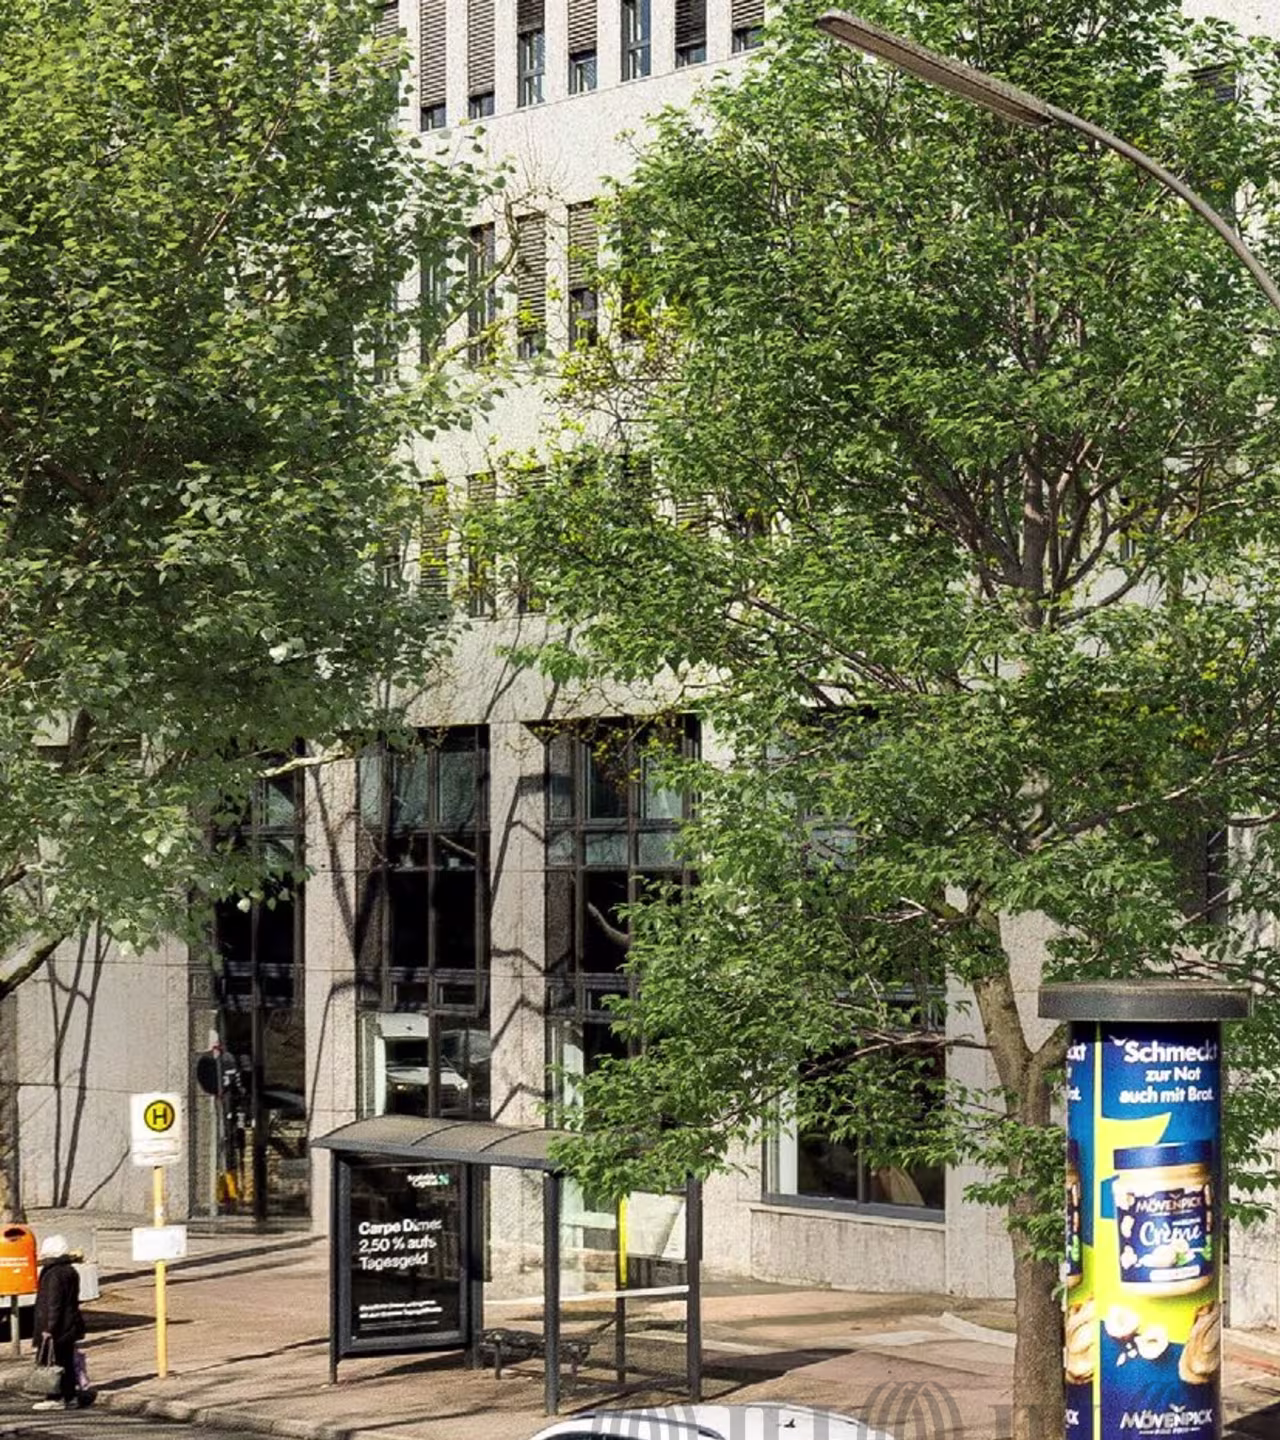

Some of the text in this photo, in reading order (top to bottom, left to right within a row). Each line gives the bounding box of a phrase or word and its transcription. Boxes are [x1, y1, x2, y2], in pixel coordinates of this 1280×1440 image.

[1123, 1040, 1218, 1063] Schmeckt
[1145, 1066, 1202, 1083] zur Not
[1119, 1086, 1214, 1104] auch mit Brot.
[152, 1107, 168, 1126] H
[358, 1220, 401, 1237] Carpe
[1139, 1220, 1203, 1247] Crème
[358, 1238, 391, 1253] 2,50
[392, 1236, 406, 1251] %
[358, 1252, 429, 1271] Tagesgeld
